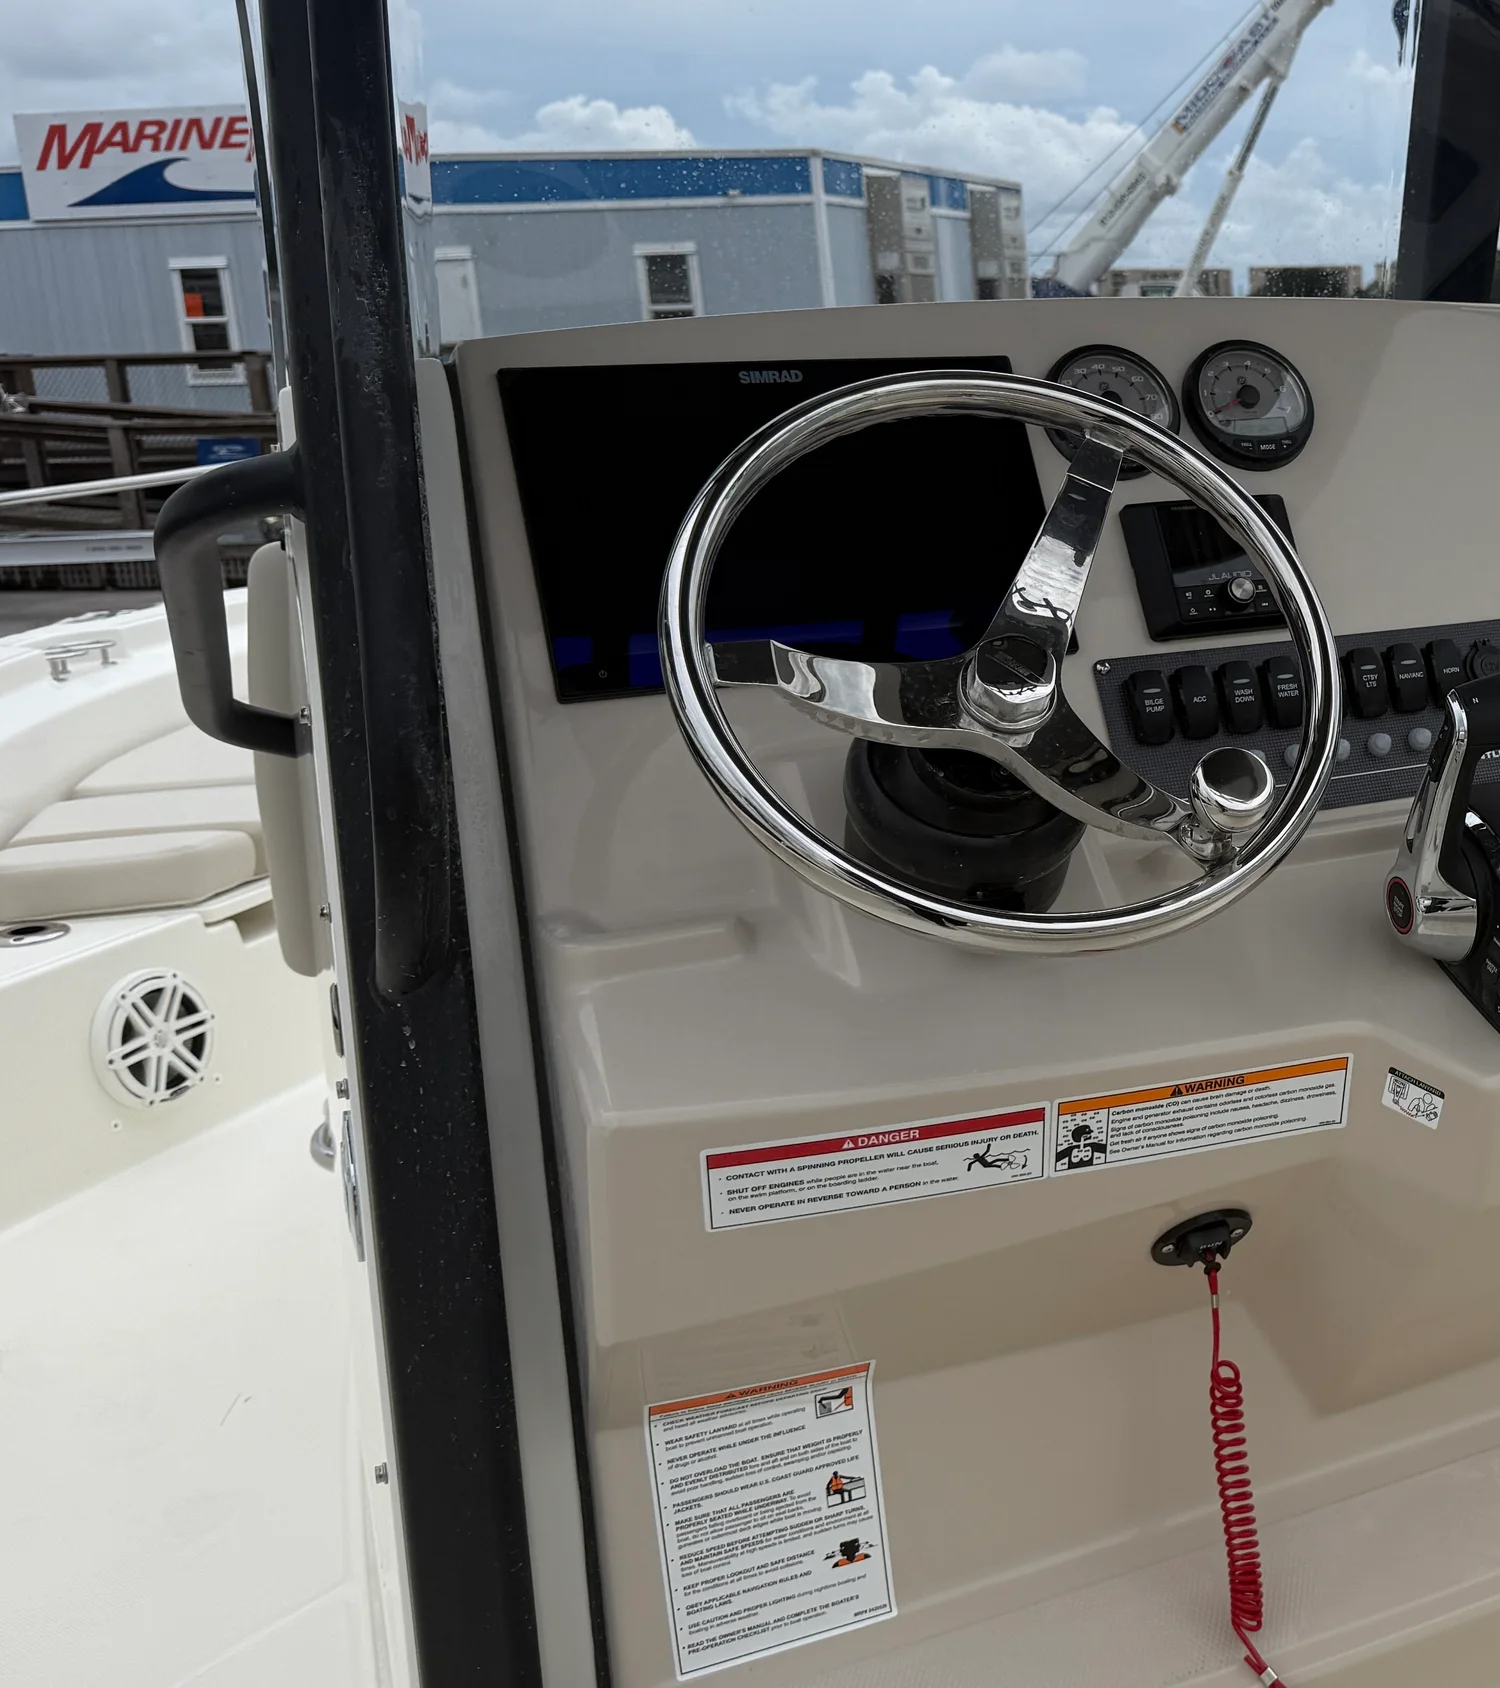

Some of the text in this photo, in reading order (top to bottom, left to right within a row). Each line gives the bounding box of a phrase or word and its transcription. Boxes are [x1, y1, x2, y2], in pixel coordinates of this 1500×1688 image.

[36, 115, 255, 172] MARINE
[738, 369, 803, 384] SIMRAD
[1234, 688, 1254, 696] WASH
[1277, 683, 1298, 691] FRESH
[1278, 690, 1300, 698] WATER
[1144, 698, 1164, 706] BILGE
[1193, 695, 1207, 703] ACC
[1235, 695, 1255, 703] DOWN
[1146, 705, 1165, 713] PUMP
[1184, 1075, 1245, 1093] WARNING
[1394, 1070, 1416, 1085] ATTACH
[1111, 1107, 1134, 1116] Carbon
[1134, 1102, 1165, 1112] monoxide
[1209, 1092, 1224, 1100] brain
[1224, 1088, 1247, 1098] damage
[857, 1129, 919, 1147] DANGER
[725, 1170, 765, 1182] CONTACT
[766, 1166, 788, 1176] WITH
[796, 1159, 836, 1171] SPINNING
[837, 1152, 885, 1165] PROPELLER
[885, 1149, 905, 1158] WILL
[906, 1145, 934, 1155] CAUSE
[935, 1139, 969, 1150] SERIOUS
[970, 1135, 998, 1145] INJURY
[999, 1133, 1011, 1141] OR
[1012, 1129, 1039, 1139] DEATH.
[726, 1187, 749, 1196] SHUT
[750, 1184, 767, 1193] OFF
[768, 1178, 805, 1190] ENGINES
[823, 1172, 846, 1183] people
[877, 1165, 895, 1174] water
[737, 1193, 749, 1201] the
[749, 1191, 767, 1199] swim
[816, 1181, 827, 1189] the
[827, 1177, 857, 1188] boarding
[728, 1205, 756, 1215] NEVER
[757, 1199, 795, 1210] OPERATE
[796, 1197, 806, 1205] IN
[806, 1192, 844, 1203] REVERSE
[845, 1186, 880, 1197] TOWARD
[888, 1180, 921, 1190] PERSON
[738, 1379, 798, 1397] WARNING
[664, 1422, 738, 1446] WEAR SAFETY LANYARD
[666, 1424, 806, 1464] NEVER OPERATE WHILE UNDER THE INFLUENCE
[671, 1492, 713, 1509] PASSENGERS
[713, 1485, 739, 1498] SHOULD
[739, 1480, 758, 1491] WEAR
[770, 1472, 792, 1483] COAST
[792, 1466, 814, 1477] GUARD
[814, 1457, 846, 1471] APPROVED
[846, 1454, 859, 1462] LIFE
[682, 1549, 815, 1591] KEEP PROPER LOOKOUT AND SAFE DISTANCE
